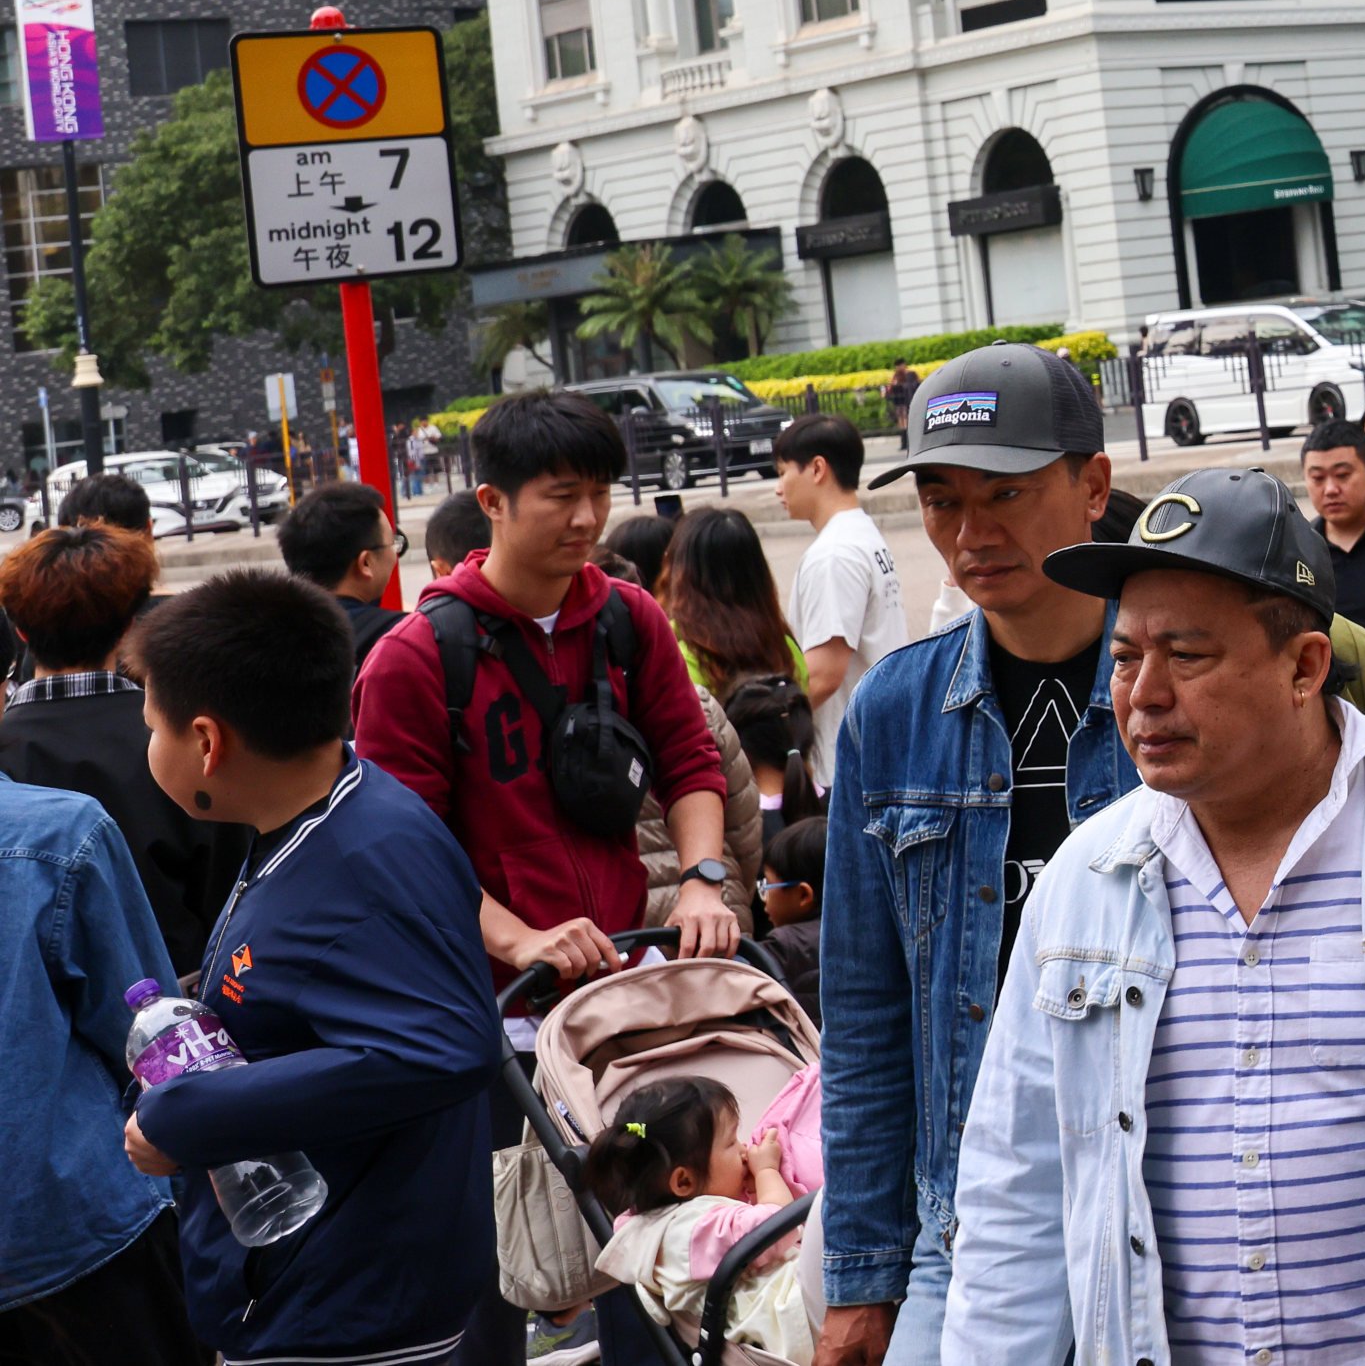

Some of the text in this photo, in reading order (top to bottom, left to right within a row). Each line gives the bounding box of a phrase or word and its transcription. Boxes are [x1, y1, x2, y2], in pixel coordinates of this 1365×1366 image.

[61, 83, 79, 134] KONG
[296, 150, 332, 167] am
[379, 147, 410, 190] 7
[287, 171, 346, 198] 上午
[268, 216, 371, 243] midnight
[386, 217, 443, 263] 12
[293, 243, 353, 272] 午夜
[927, 410, 991, 430] patagonia
[1139, 492, 1202, 543] C
